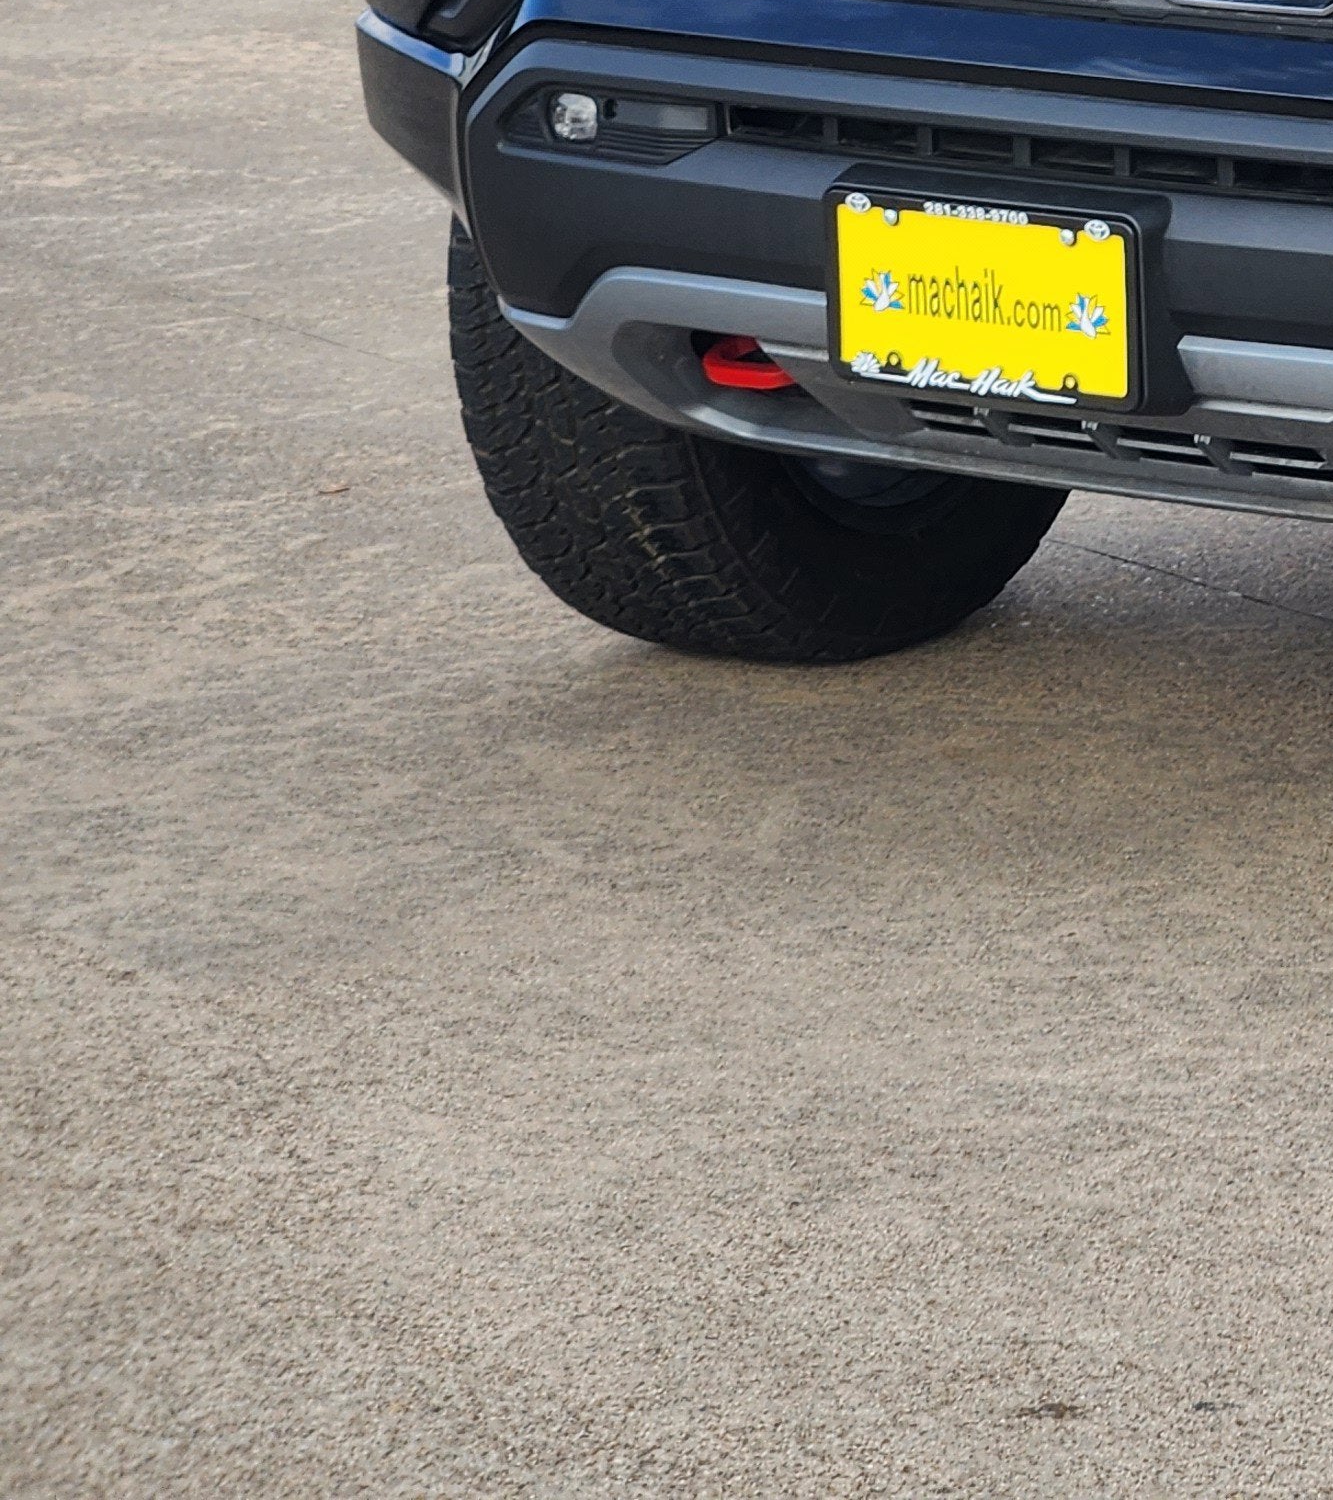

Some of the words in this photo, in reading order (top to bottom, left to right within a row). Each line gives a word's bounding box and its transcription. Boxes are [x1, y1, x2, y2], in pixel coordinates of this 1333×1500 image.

[907, 265, 1063, 332] machaik.com
[905, 357, 967, 388] Mac
[969, 367, 1037, 397] Haik
